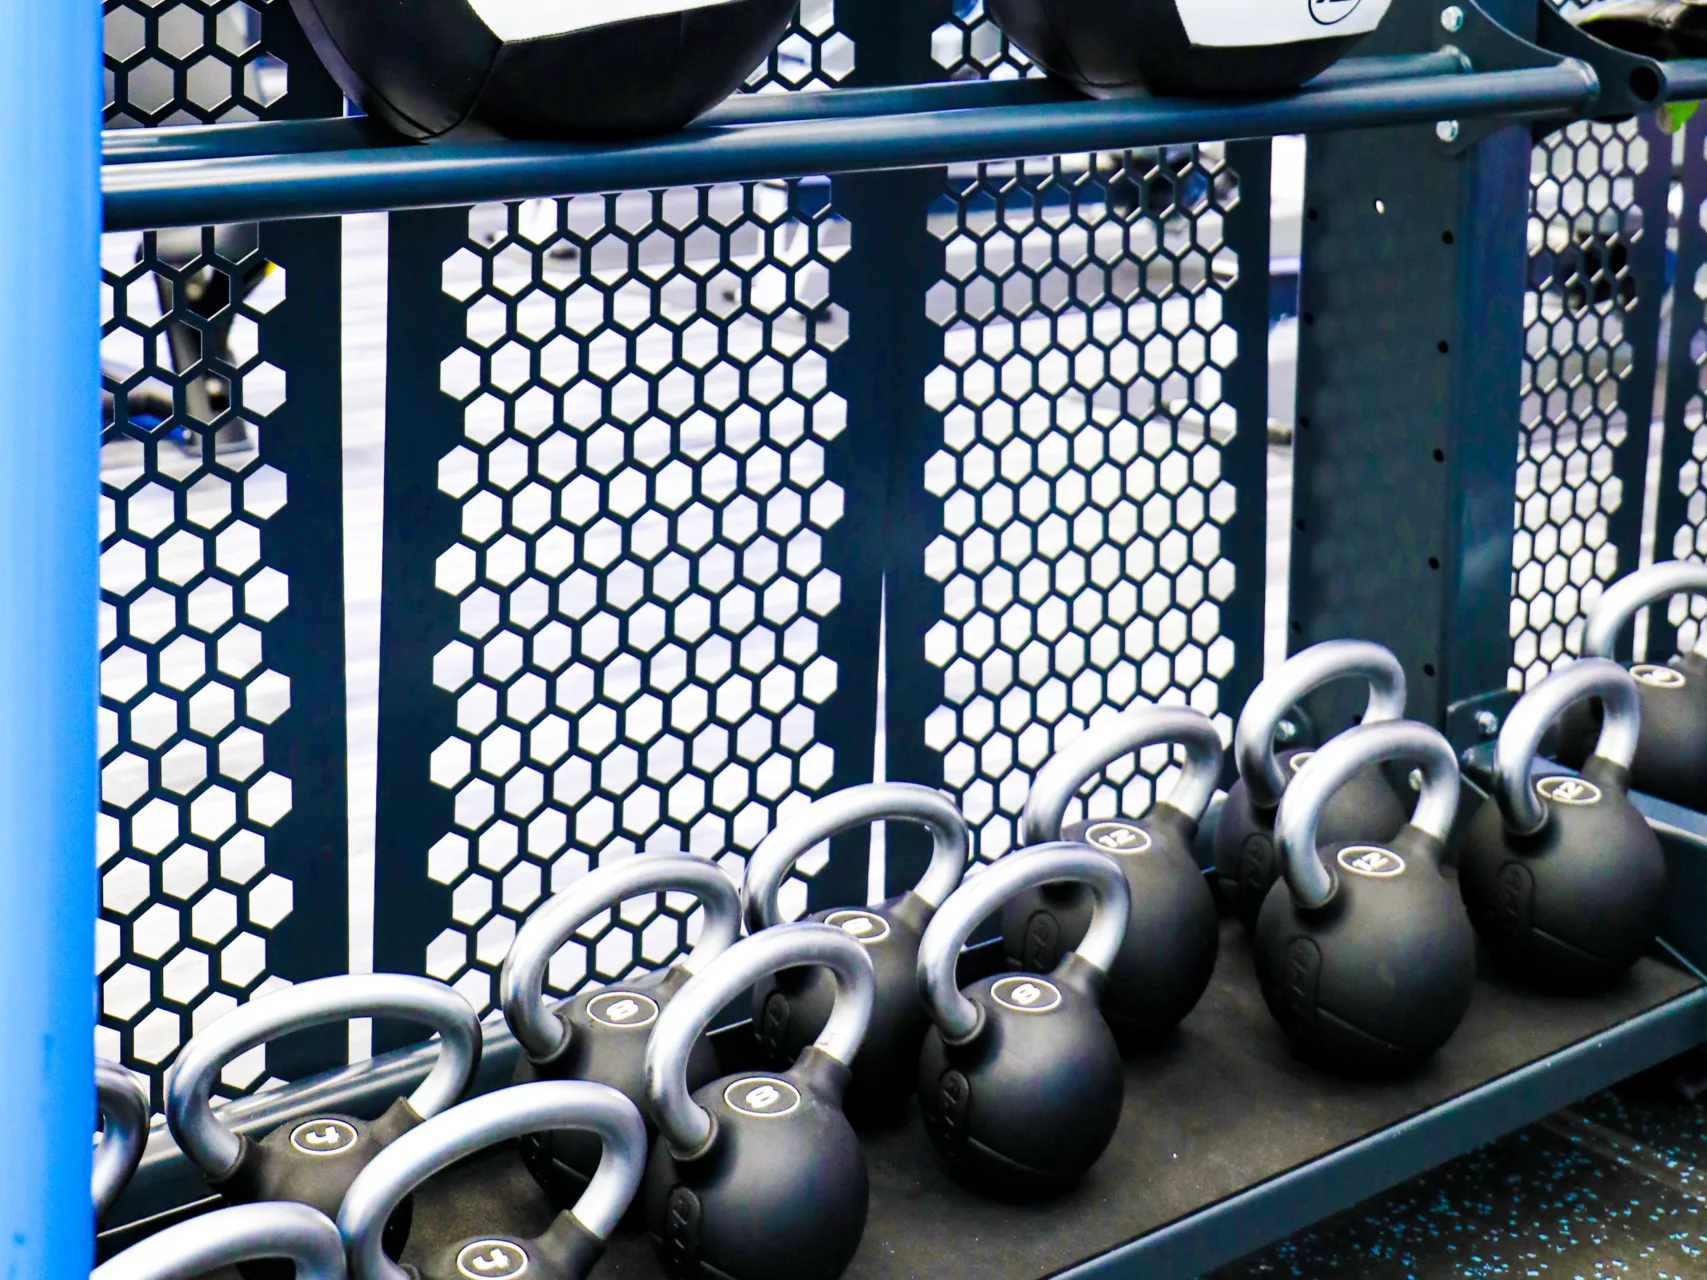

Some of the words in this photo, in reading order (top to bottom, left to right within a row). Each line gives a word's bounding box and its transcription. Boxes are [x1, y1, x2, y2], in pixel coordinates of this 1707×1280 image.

[1098, 828, 1136, 848] 12
[1352, 852, 1388, 871] 12
[1011, 983, 1041, 1005] 8
[606, 999, 639, 1021] 8
[745, 1085, 779, 1108] 8
[305, 1126, 340, 1145] 4
[472, 1246, 510, 1271] 4
